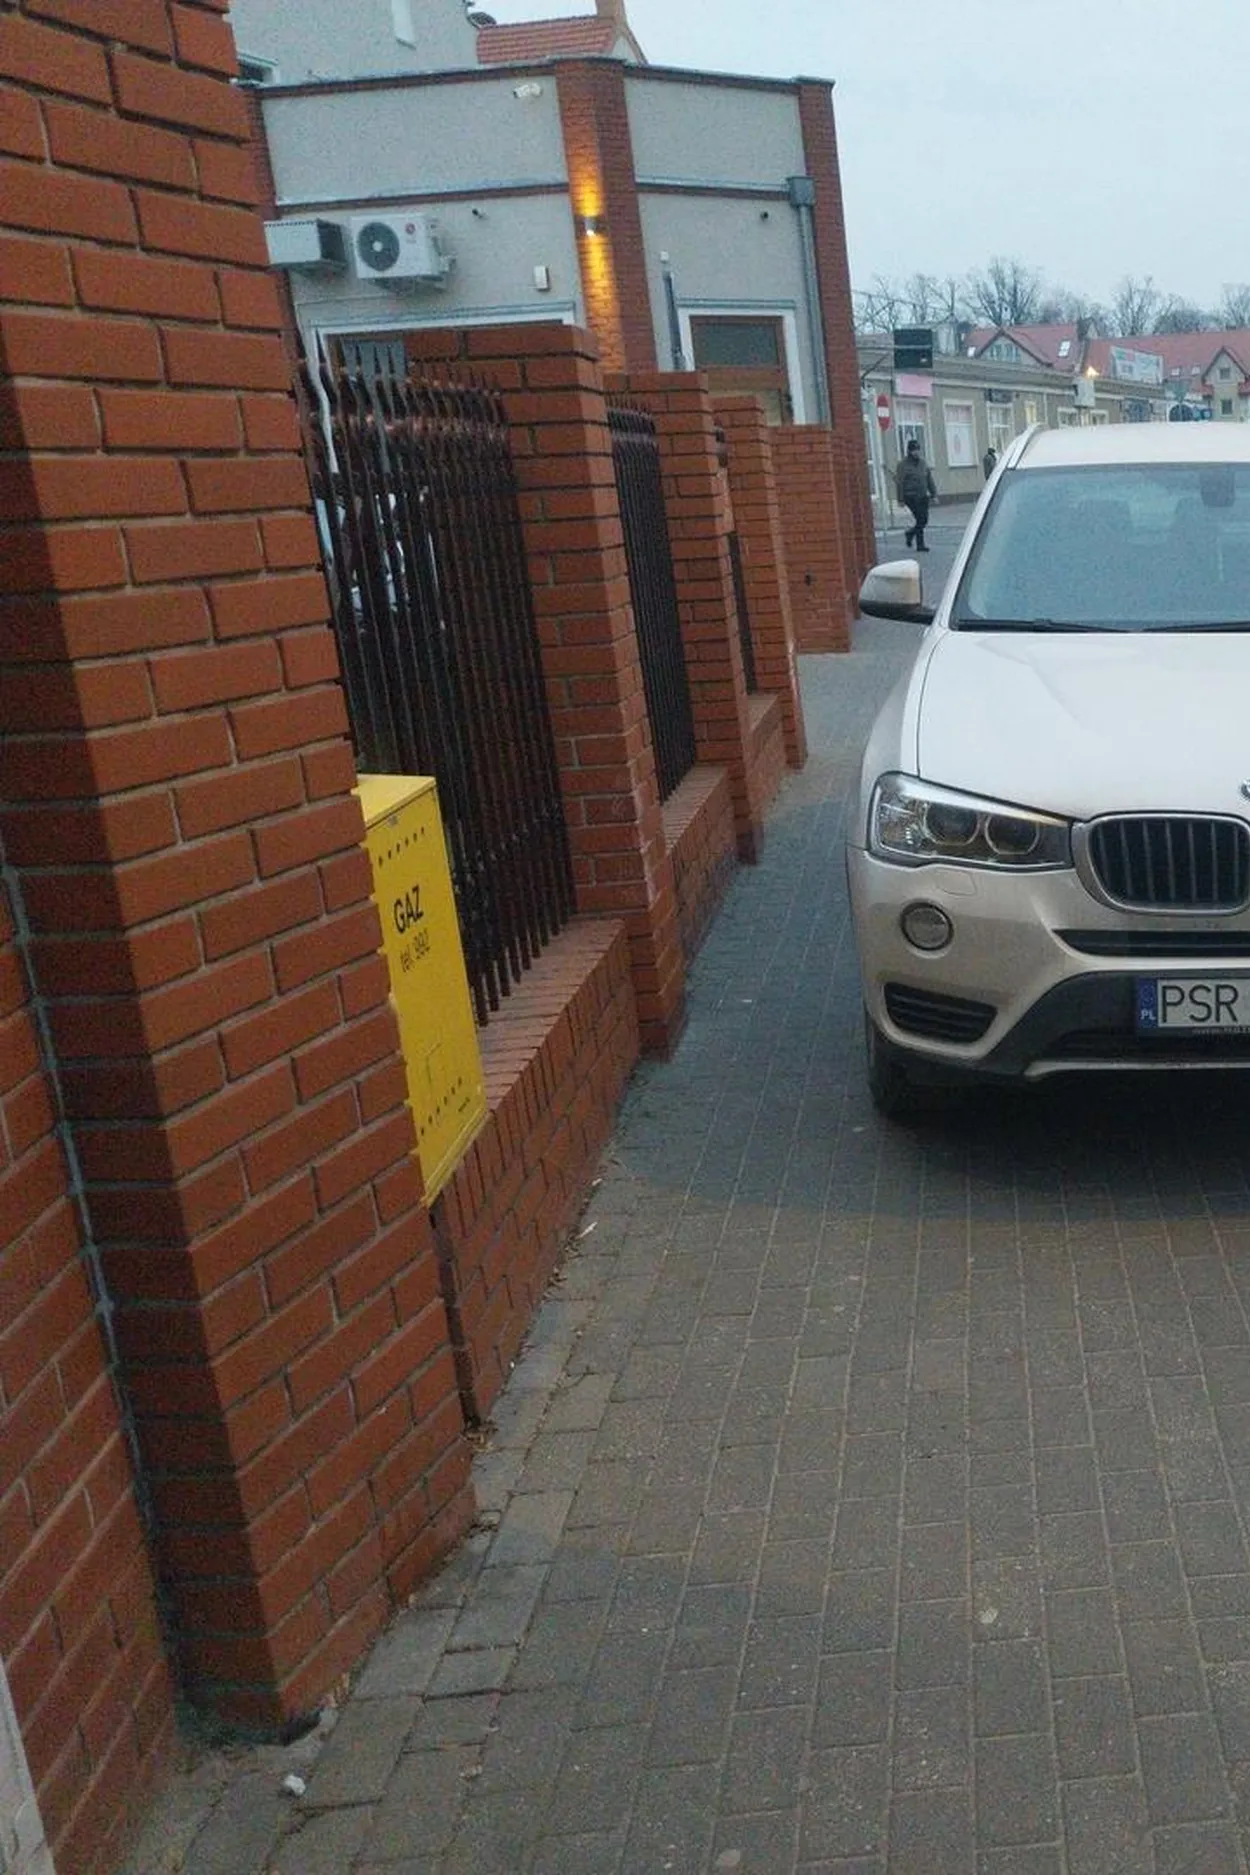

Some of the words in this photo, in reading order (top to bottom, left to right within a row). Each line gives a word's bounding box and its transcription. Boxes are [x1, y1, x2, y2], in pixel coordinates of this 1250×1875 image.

[393, 884, 424, 934] GAZ
[1140, 1010, 1156, 1021] PL
[1161, 984, 1239, 1023] PSR
